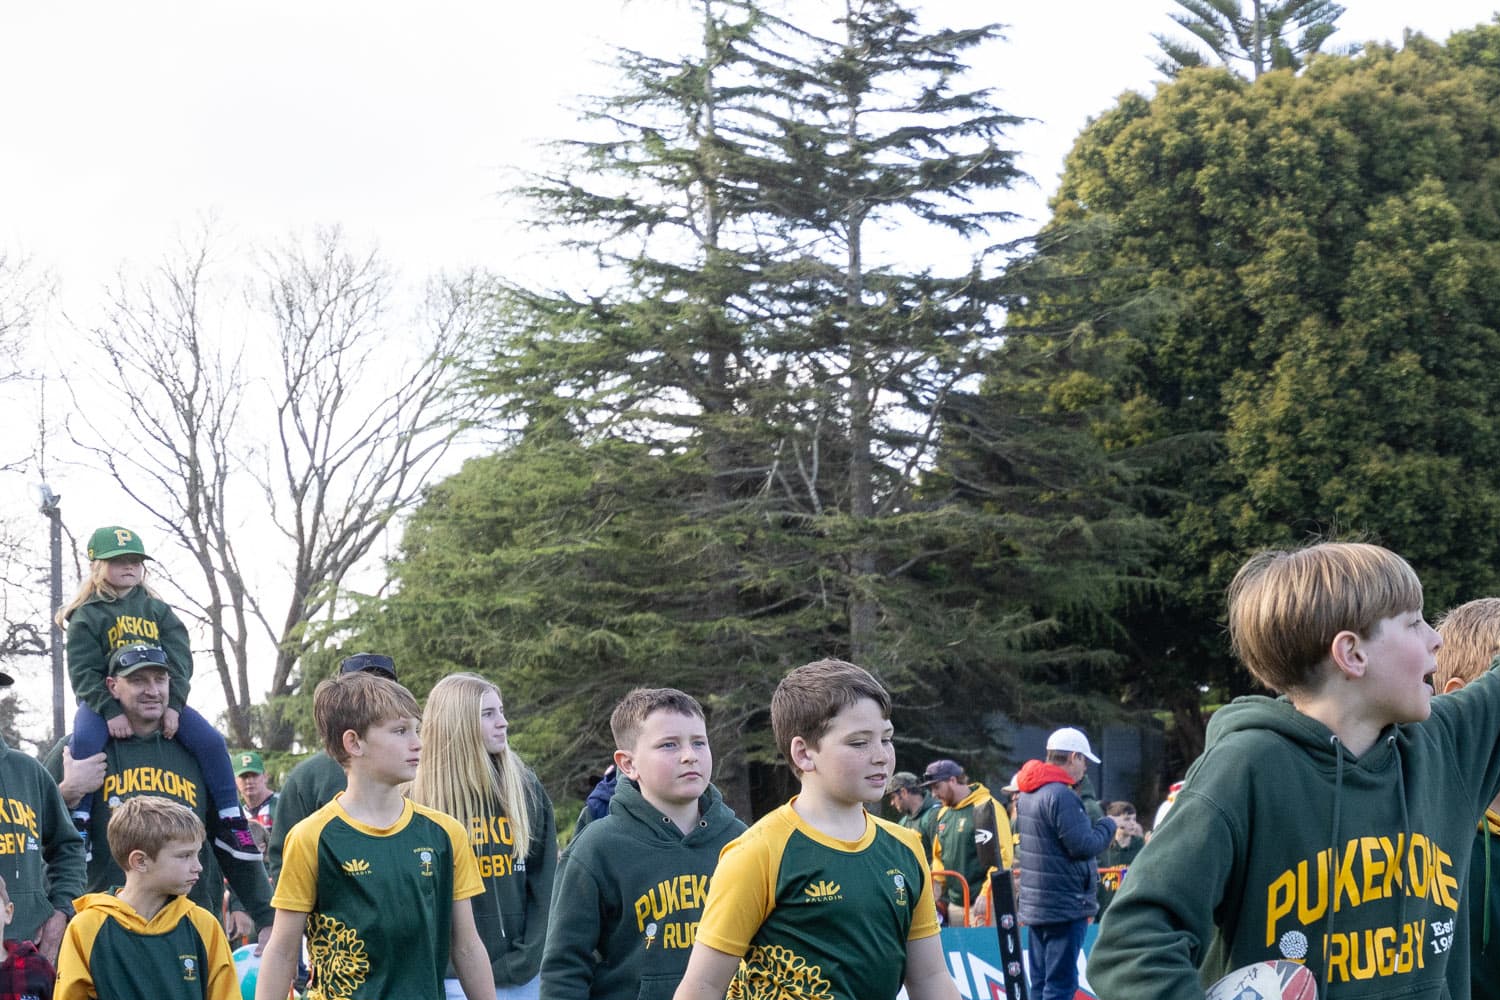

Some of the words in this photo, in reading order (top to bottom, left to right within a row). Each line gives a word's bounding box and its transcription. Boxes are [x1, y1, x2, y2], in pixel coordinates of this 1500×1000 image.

[114, 529, 132, 547] P
[103, 766, 198, 808] PUKEKOHE
[805, 895, 843, 904] PALADIN
[1265, 831, 1459, 949] PUKEKOHE
[1322, 917, 1426, 984] RUGBY
